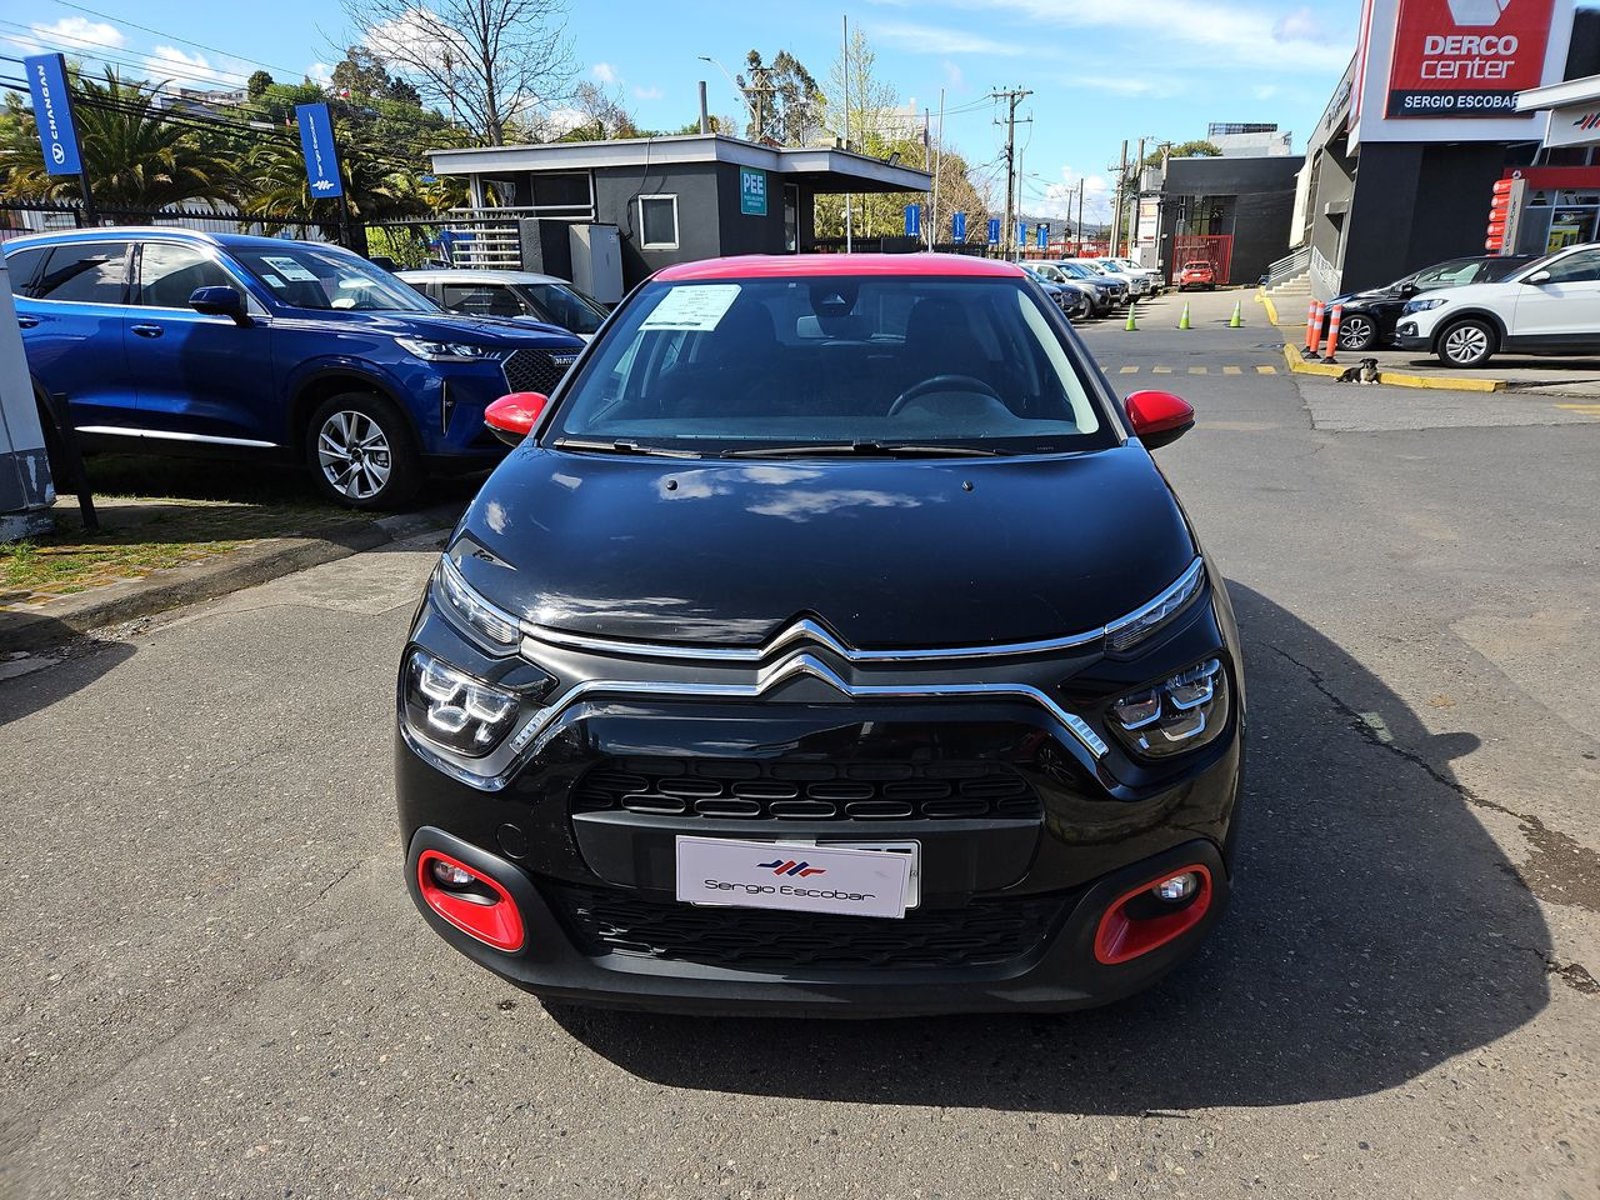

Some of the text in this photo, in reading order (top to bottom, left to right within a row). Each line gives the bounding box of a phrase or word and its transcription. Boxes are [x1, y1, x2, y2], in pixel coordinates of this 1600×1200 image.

[1424, 35, 1519, 55] DERCO
[1421, 57, 1515, 79] center
[37, 65, 59, 140] CHANGAN
[1404, 95, 1454, 108] SERGIO
[743, 173, 764, 195] PEE
[704, 879, 876, 901] Sergio Escobar
